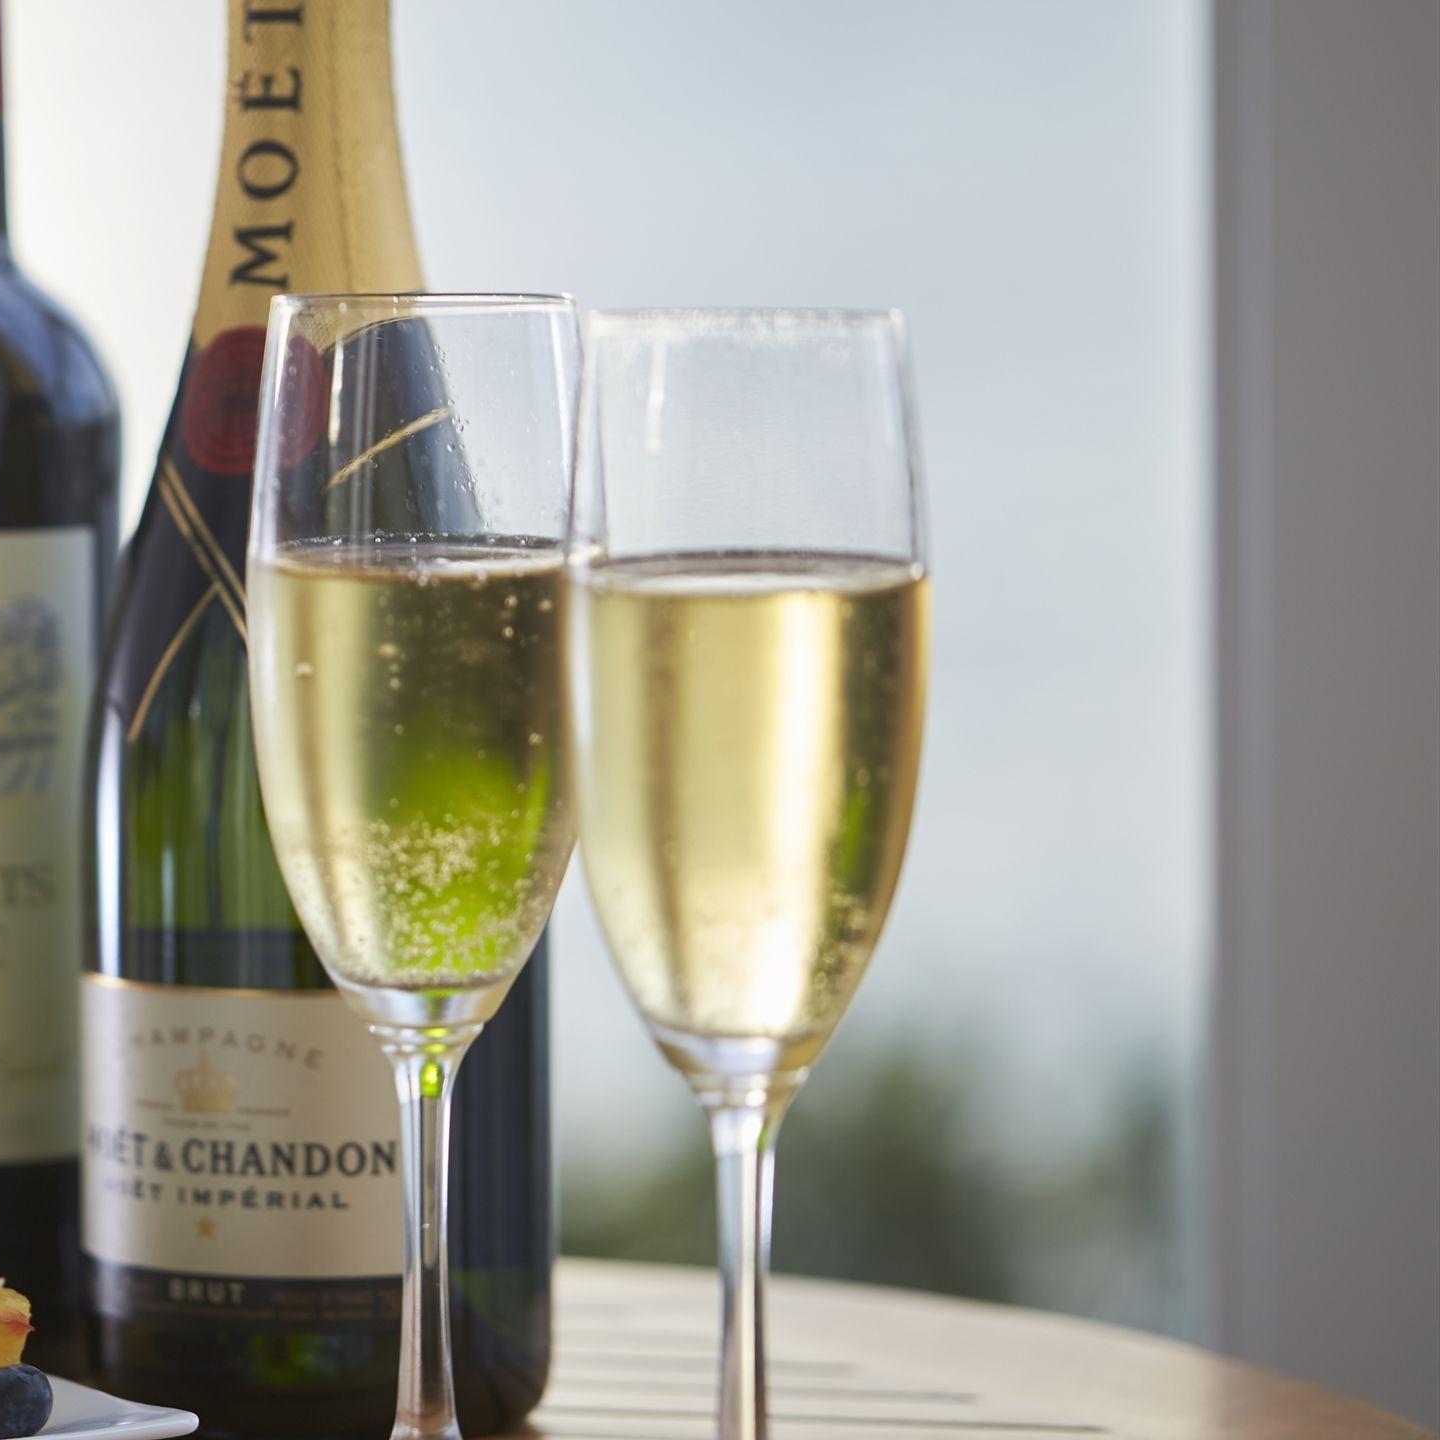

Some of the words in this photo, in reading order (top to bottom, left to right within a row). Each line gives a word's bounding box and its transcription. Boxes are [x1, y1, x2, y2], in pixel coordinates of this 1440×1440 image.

[229, 0, 305, 290] MOËT
[117, 1025, 327, 1072] HAMPAGNE
[152, 1140, 176, 1174] &
[179, 1137, 399, 1178] CHANDON
[175, 1183, 351, 1213] IMPÉRIAL
[168, 1278, 246, 1306] BRUT
